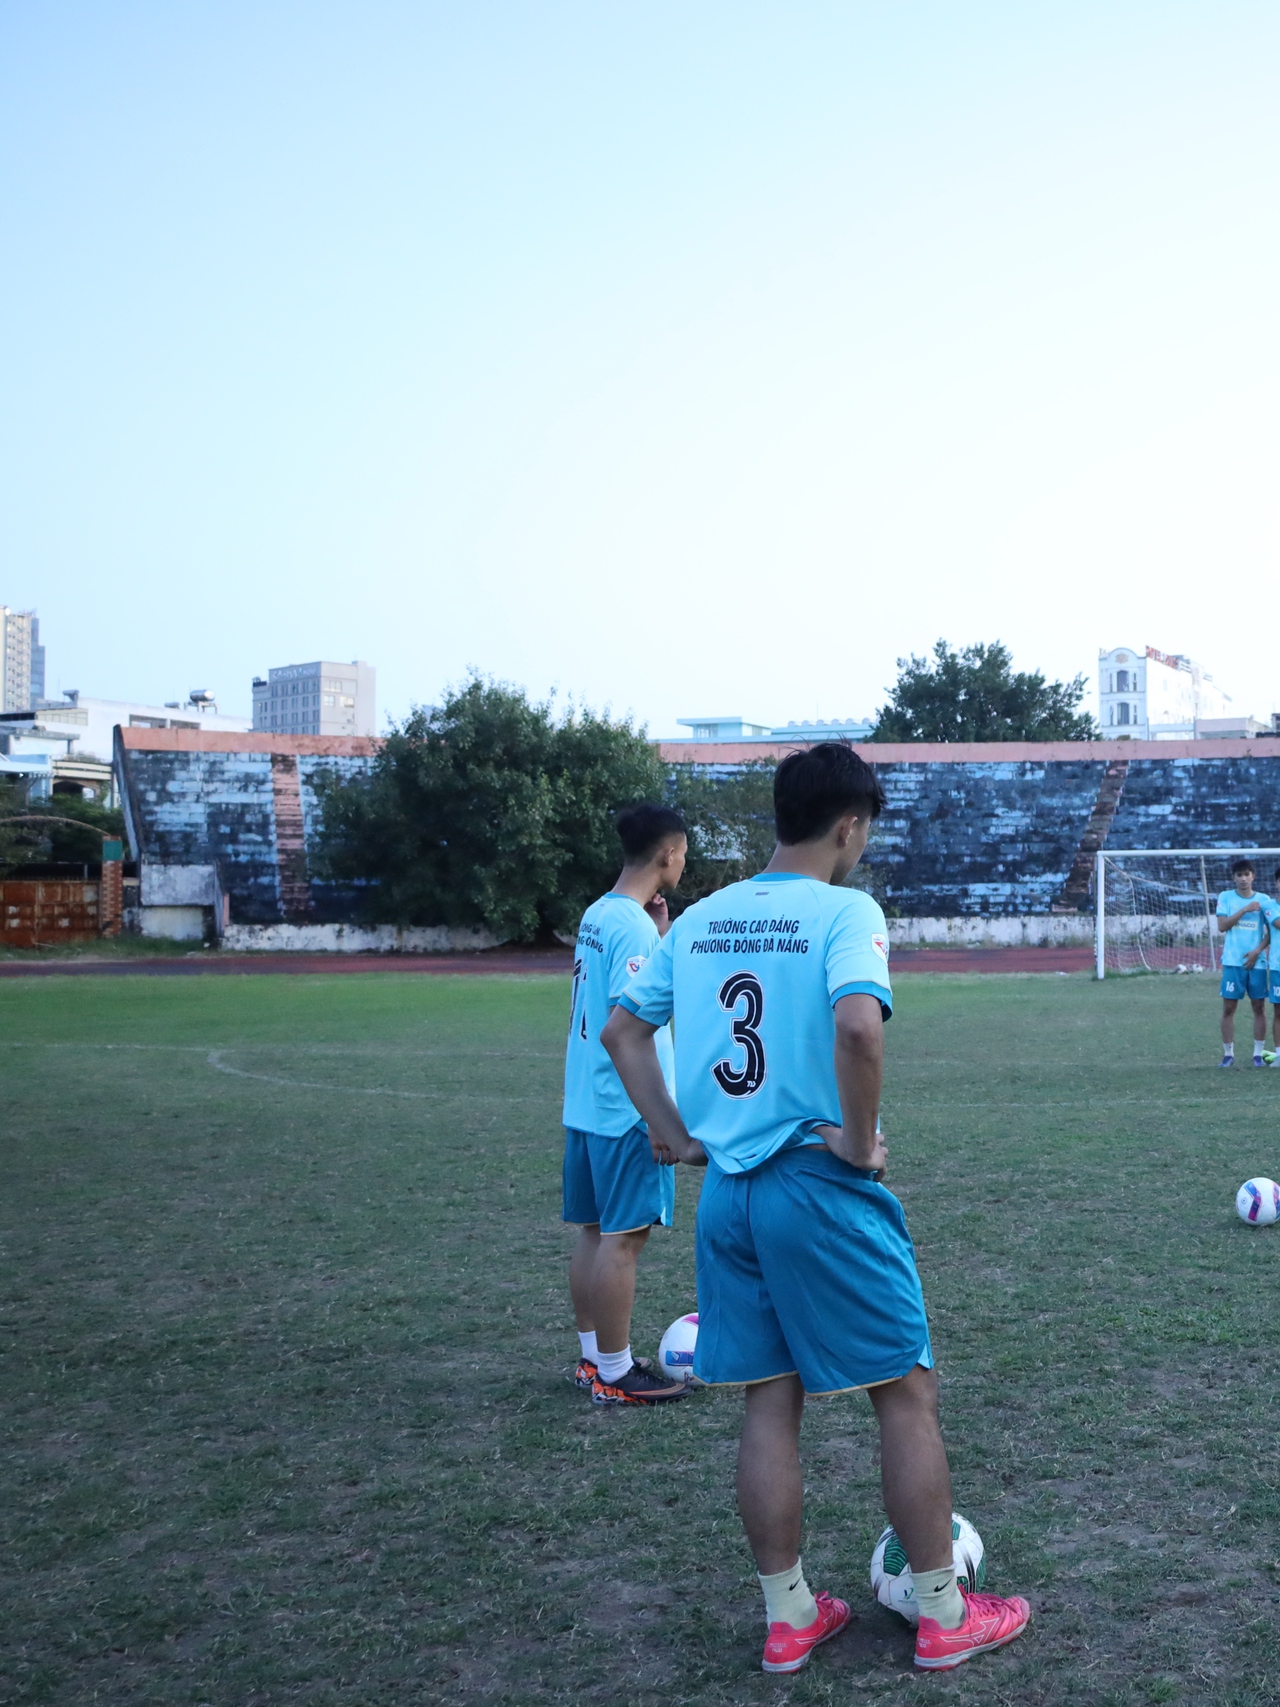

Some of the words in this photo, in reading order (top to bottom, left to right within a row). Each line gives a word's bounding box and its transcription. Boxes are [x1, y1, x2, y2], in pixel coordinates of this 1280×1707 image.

[708, 917, 747, 935] TRƯỜNG
[749, 919, 768, 934] CAO
[769, 914, 800, 934] ĐẲNG
[690, 938, 731, 954] PHƯƠNG
[733, 936, 761, 954] ĐÔNG
[763, 934, 774, 953] ĐÀ
[776, 934, 809, 954] NẴNG
[1225, 981, 1235, 992] 16
[710, 969, 767, 1099] 3
